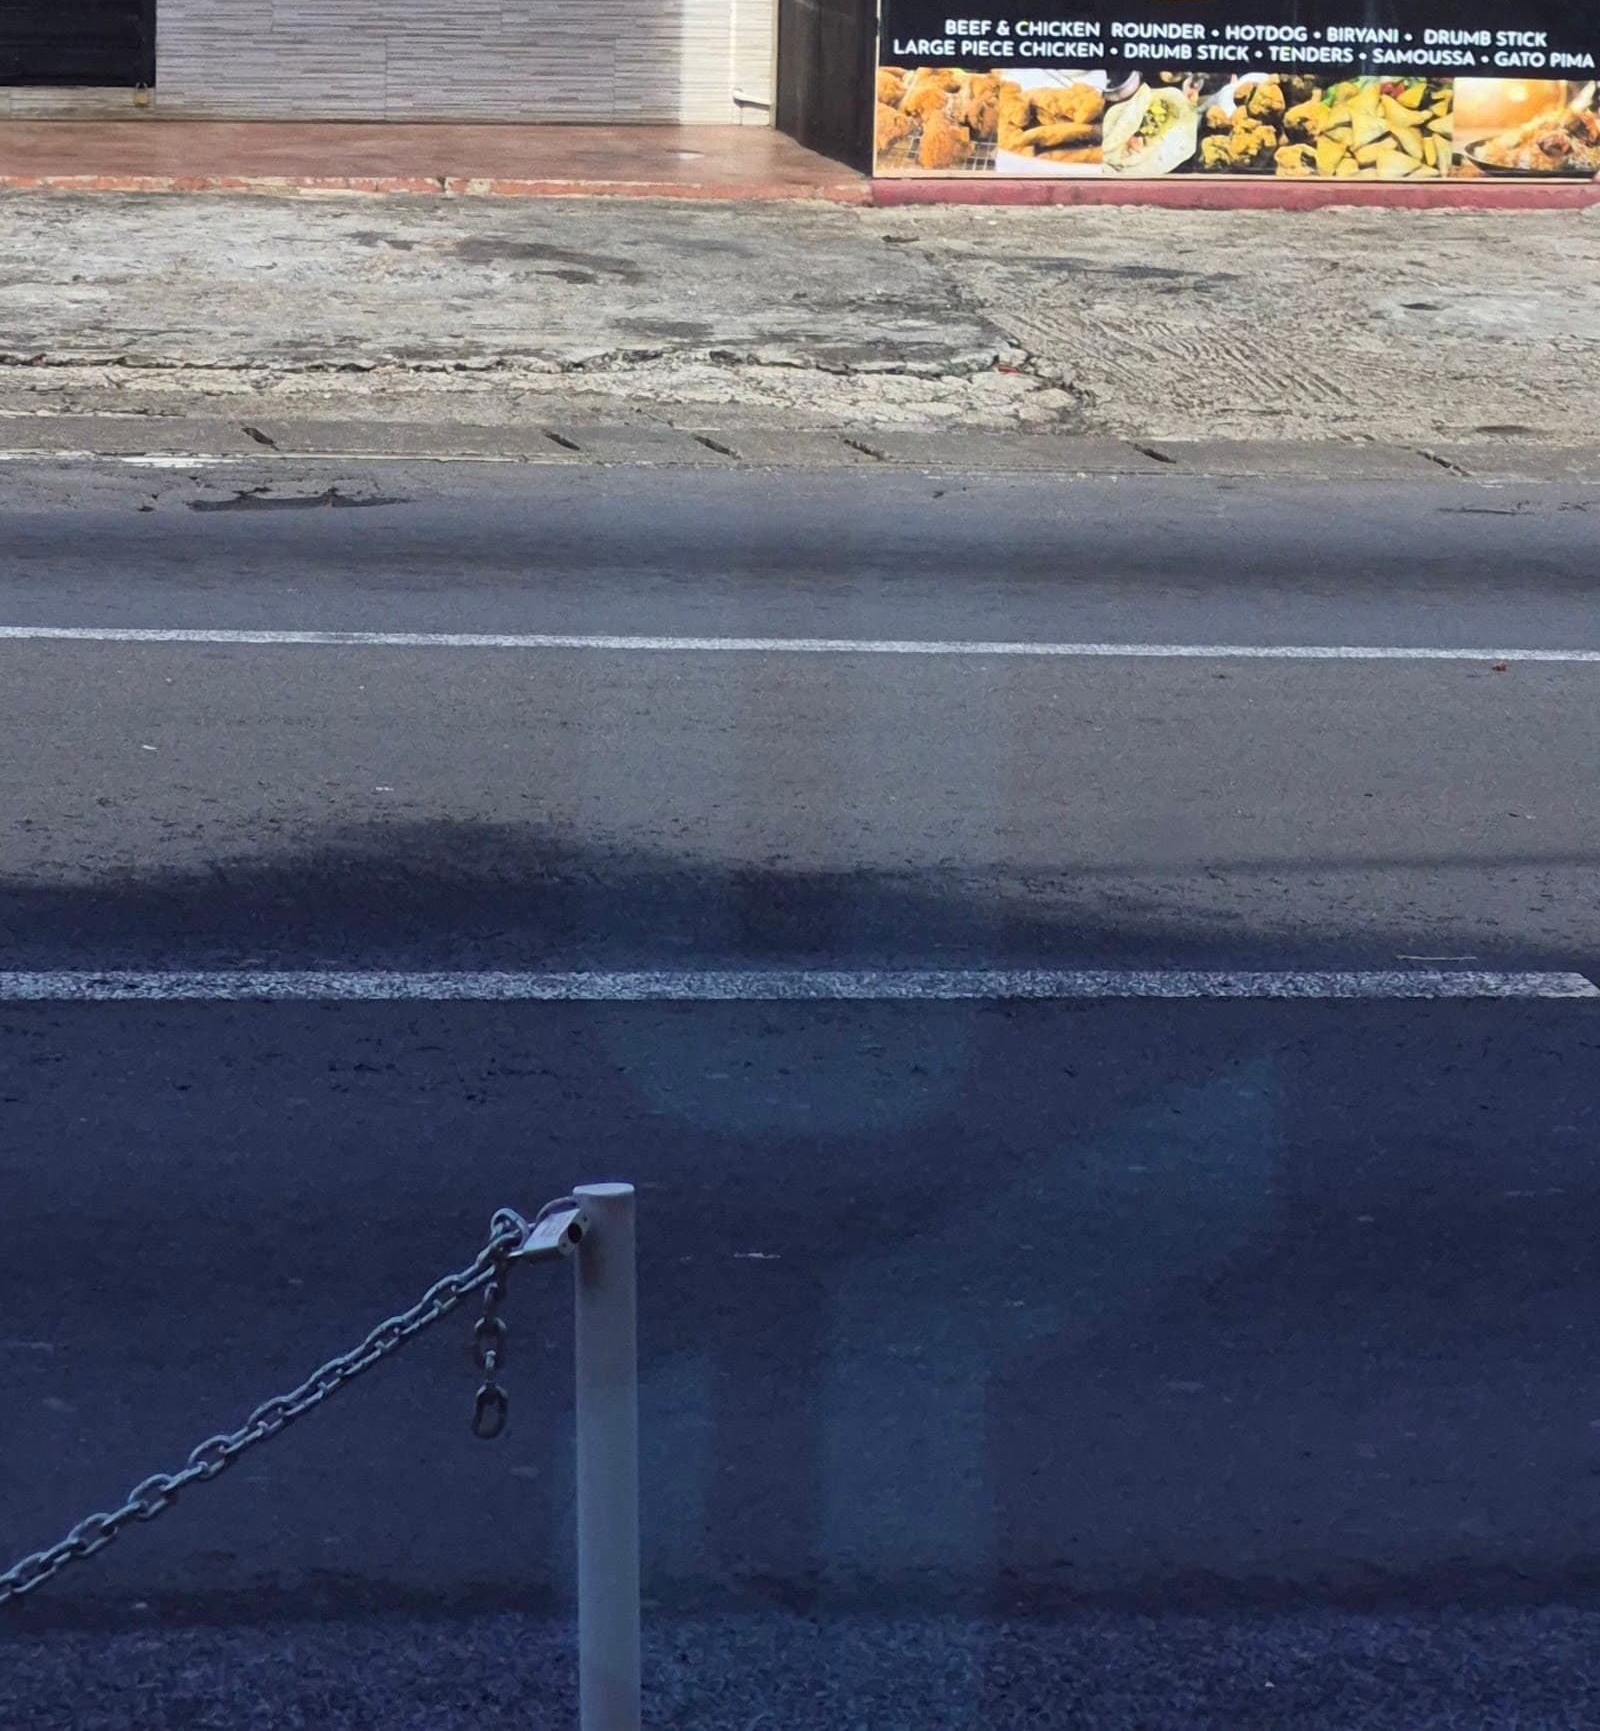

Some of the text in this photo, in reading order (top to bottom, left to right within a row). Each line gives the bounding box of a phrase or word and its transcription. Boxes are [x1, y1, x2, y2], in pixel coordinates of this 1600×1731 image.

[945, 19, 1548, 48] BEEF & CHICKEN ROUNDER HOTDOG BIRYANI DRUMB STICK
[893, 39, 1596, 69] LARGE PIECE CHICKEN DRUMB STICK TENDERS SAMOUSSA GATO PIMA
